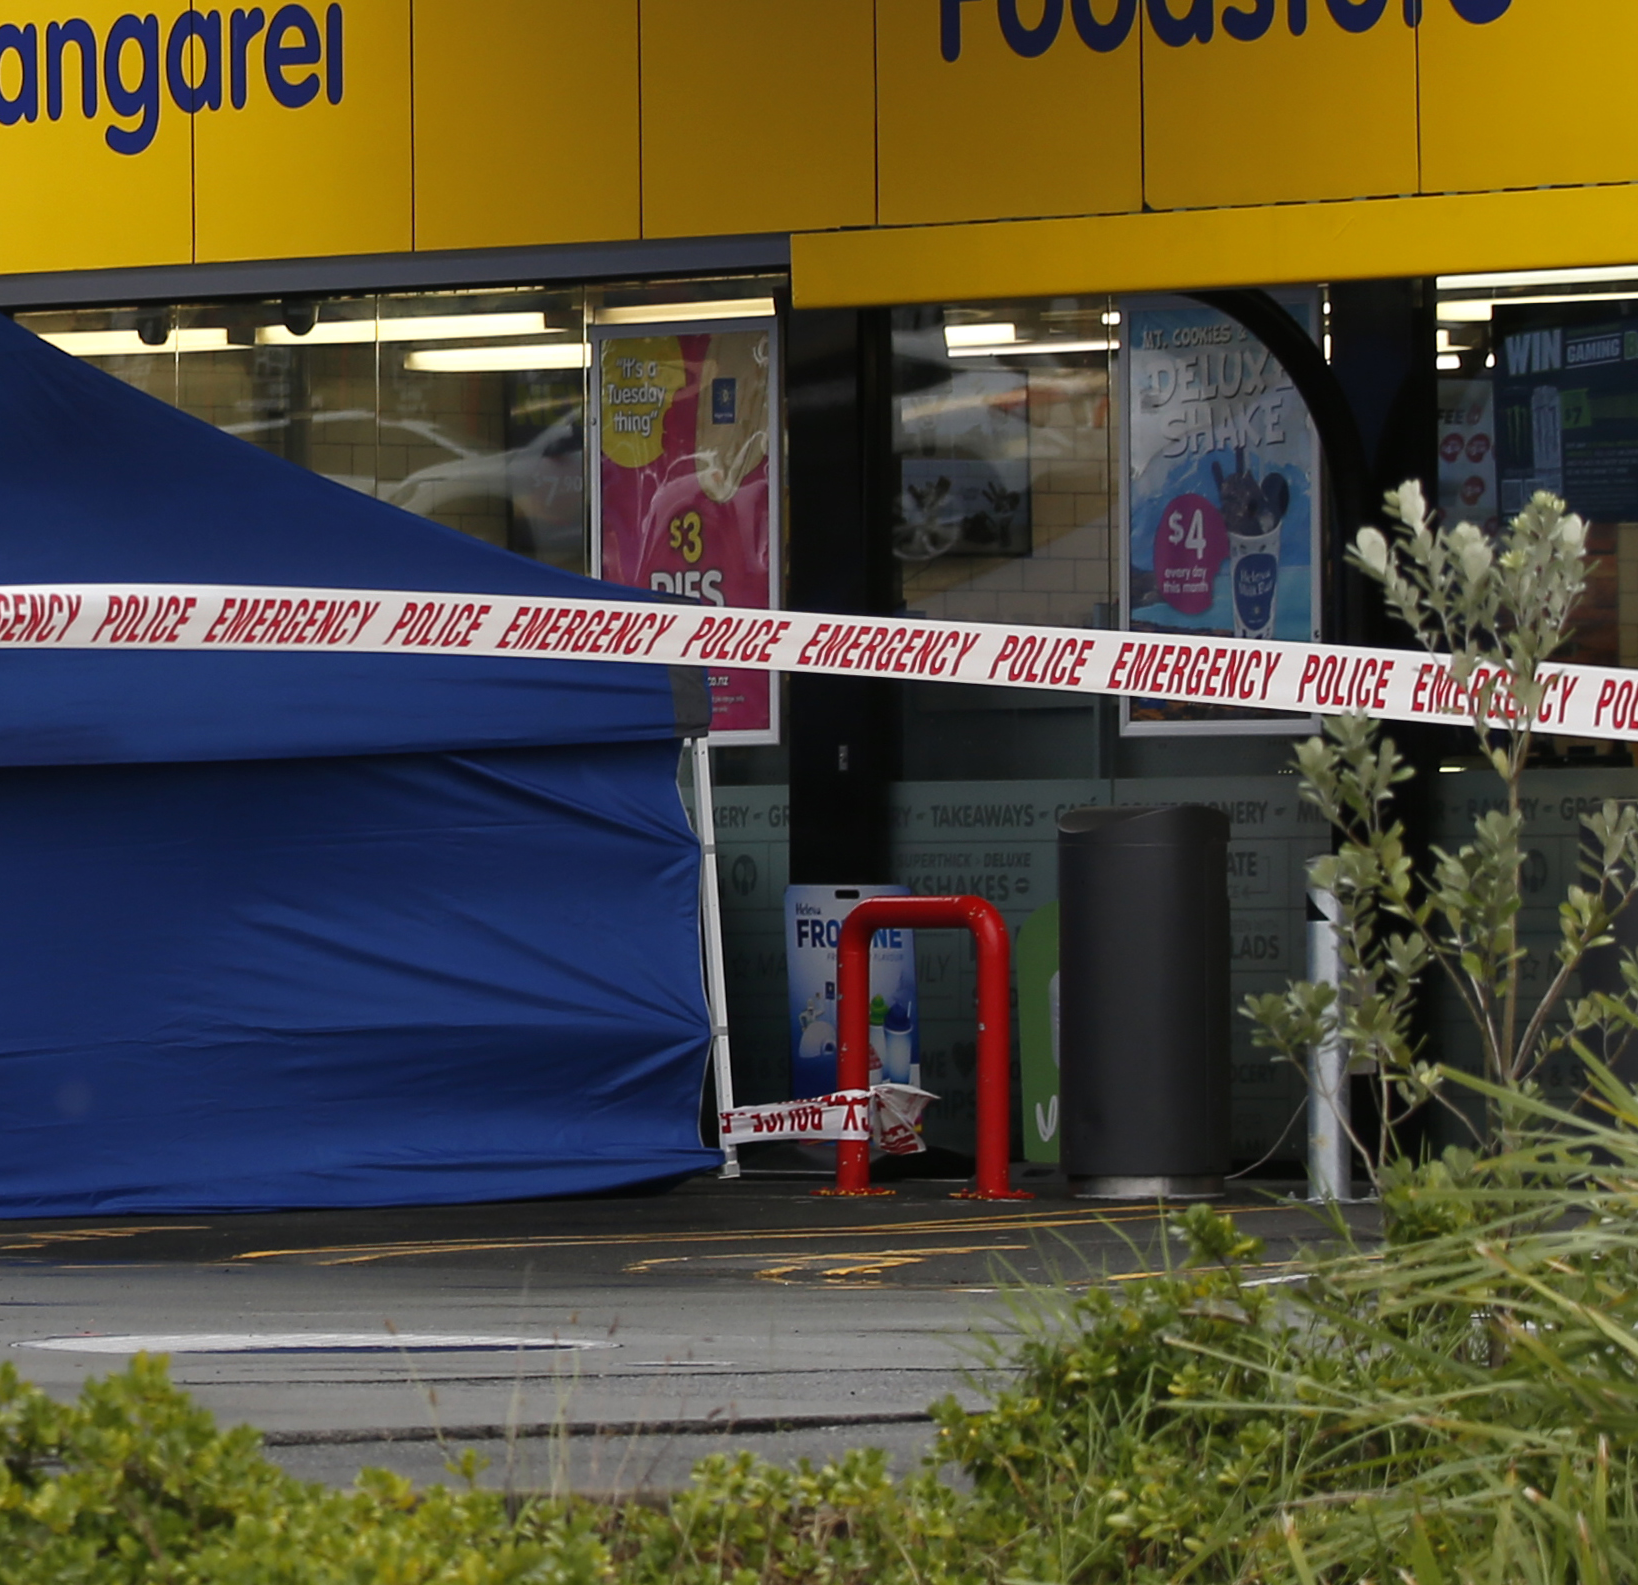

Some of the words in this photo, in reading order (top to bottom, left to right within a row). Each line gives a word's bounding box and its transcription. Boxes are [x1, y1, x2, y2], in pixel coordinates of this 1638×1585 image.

[1505, 327, 1562, 375] WIN
[1567, 337, 1621, 364] GAMING
[647, 361, 657, 378] a
[607, 383, 665, 408] Tuesday
[1162, 397, 1286, 459] SHAKE
[669, 511, 703, 563] $3
[1168, 509, 1207, 560] $4
[90, 594, 197, 644] POLICE
[202, 597, 381, 646] EMERGENCY
[382, 601, 492, 649] POLICE
[495, 605, 679, 657] EMERGENCY
[681, 616, 792, 664] POLICE
[796, 623, 981, 677] EMERGENCY
[988, 634, 1095, 686] POLICE
[1107, 642, 1282, 701] EMERGENCY
[1296, 653, 1394, 710] POLICE
[931, 805, 1034, 828] TAKEAWAYS
[984, 853, 1031, 868] DELUXE
